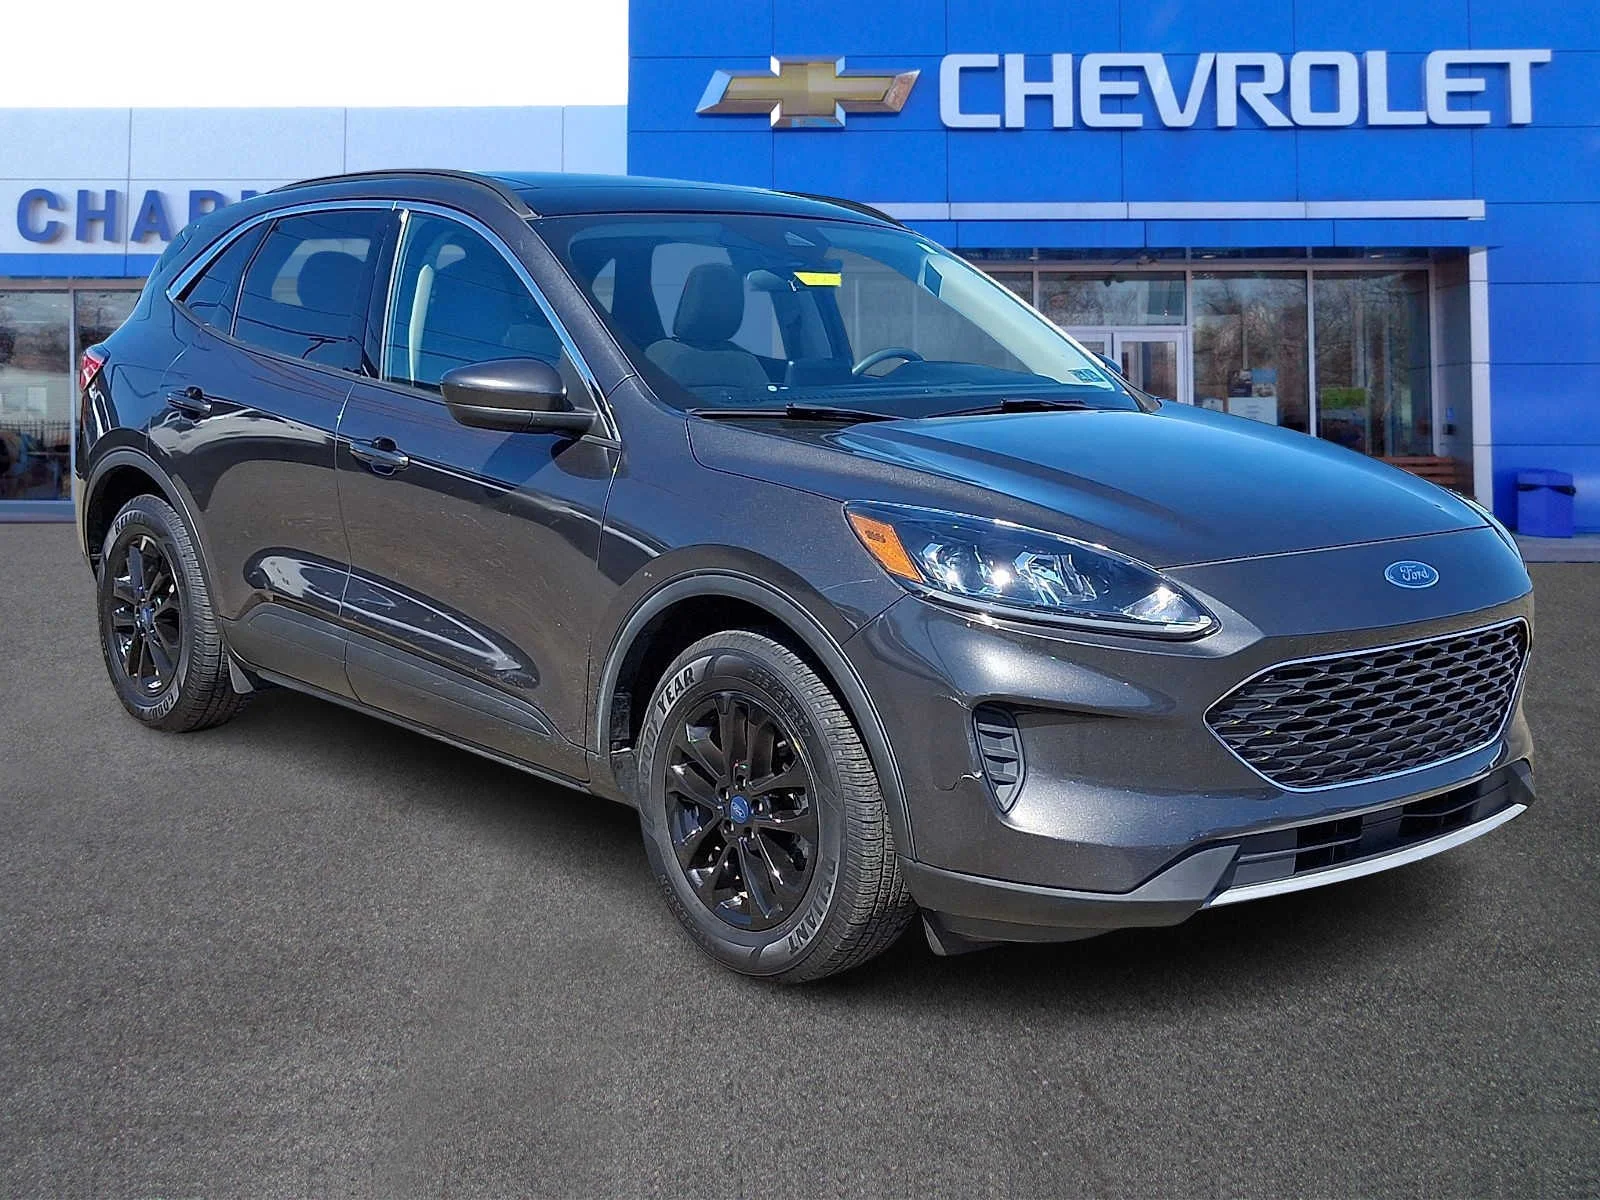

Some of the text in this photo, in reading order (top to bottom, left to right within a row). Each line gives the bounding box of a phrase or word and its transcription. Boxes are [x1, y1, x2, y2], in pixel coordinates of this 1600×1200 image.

[939, 49, 1552, 128] CHEVROLET
[1399, 565, 1430, 581] Ford
[656, 666, 696, 716] YEAR
